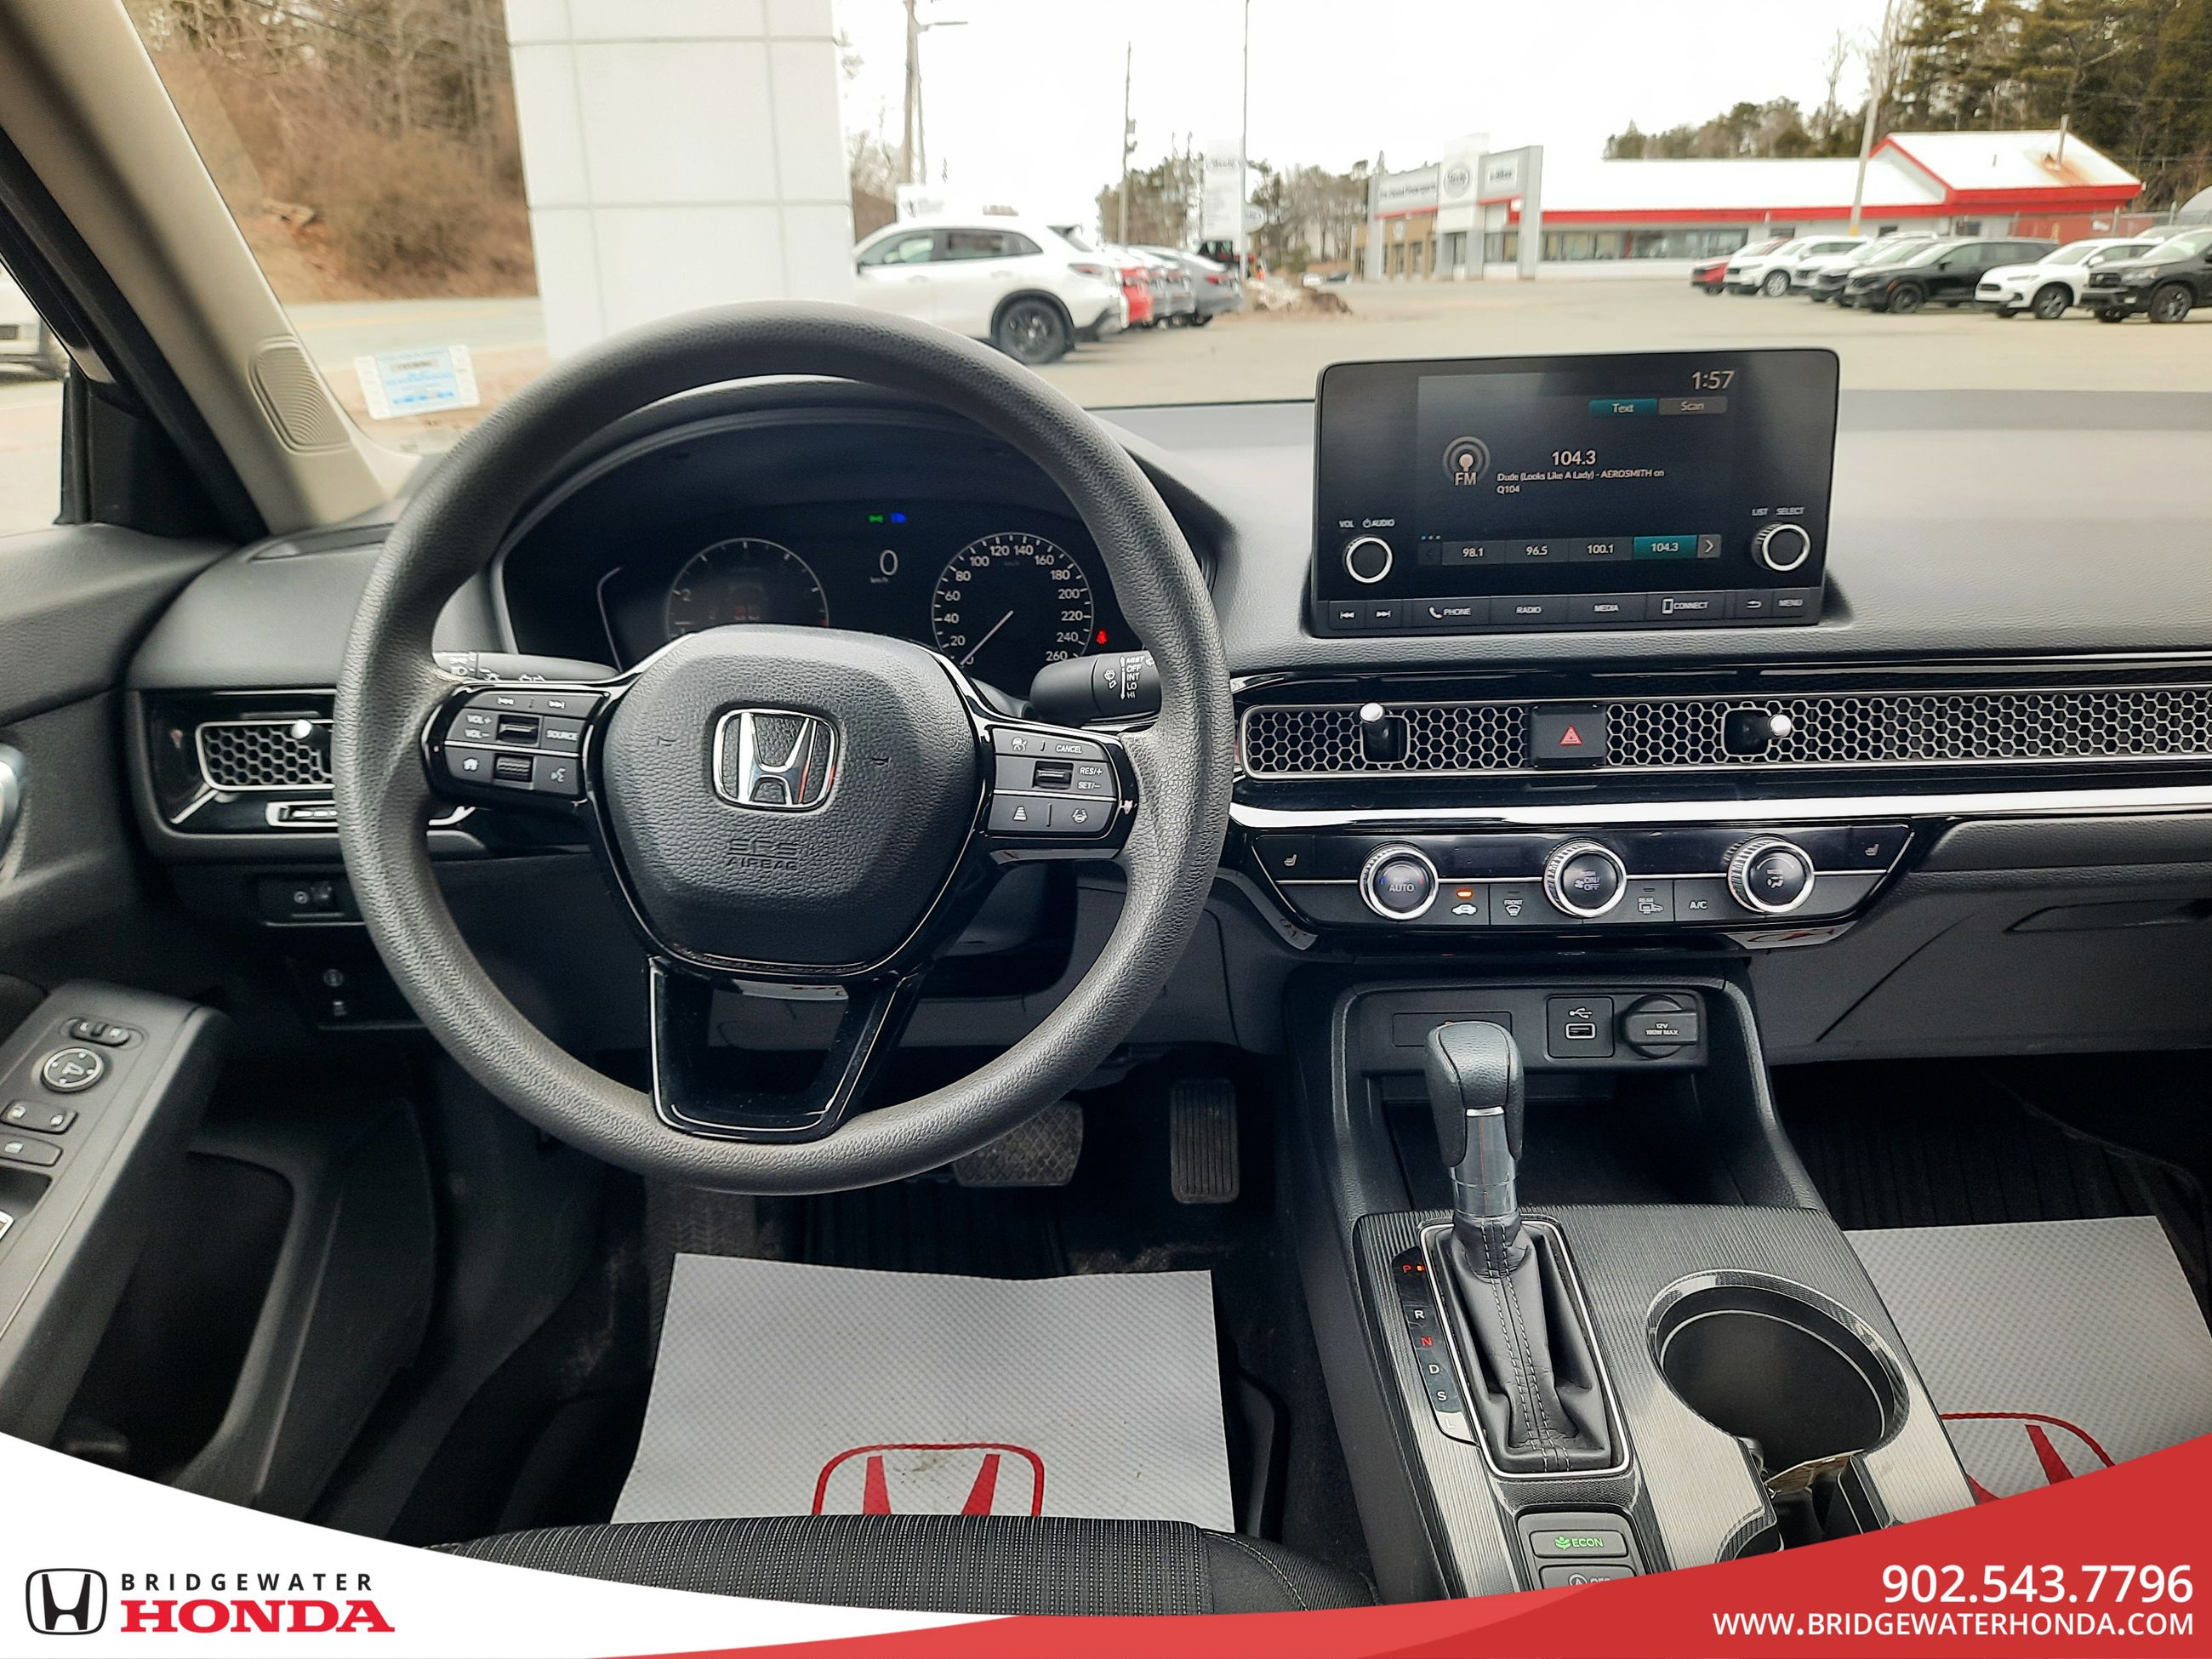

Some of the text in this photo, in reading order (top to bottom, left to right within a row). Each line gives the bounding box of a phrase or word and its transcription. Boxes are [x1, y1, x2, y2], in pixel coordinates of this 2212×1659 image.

[1691, 371, 1735, 391] 1:57
[1612, 403, 1634, 413] Text
[1680, 402, 1705, 412] Scan
[1551, 450, 1597, 466] 104.3
[1455, 472, 1477, 486] FM
[1497, 473, 1519, 482] Dude
[1520, 472, 1545, 482] (Looks
[1547, 472, 1564, 481] Like
[1564, 471, 1572, 480] A
[1573, 470, 1594, 481] Lady)
[1600, 470, 1652, 478] AEROSMITH
[1497, 485, 1520, 494] Q104
[1751, 507, 1804, 516] LIST SELECT
[1371, 518, 1395, 527] AUDIO
[989, 544, 1011, 556] 120
[1013, 544, 1035, 556] 140
[1525, 545, 1548, 556] 96.5
[1587, 544, 1614, 554] 100.1
[1650, 542, 1679, 552] 104.3
[1462, 547, 1484, 558] 98.1
[879, 550, 898, 576] 0
[969, 556, 990, 567] 100
[1035, 555, 1055, 566] 160
[955, 571, 972, 582] 80
[1050, 569, 1071, 580] 180
[944, 590, 961, 601] 60
[1058, 588, 1080, 600] 200
[1515, 606, 1542, 614] RADIO
[1593, 604, 1619, 613] MEDIA
[1673, 601, 1708, 610] CONNECT
[1061, 610, 1084, 621] 220
[1444, 607, 1471, 617] PHONE
[944, 613, 960, 624] 40
[950, 636, 966, 647] 20
[1056, 631, 1079, 642] 240
[1046, 651, 1069, 662] 260
[1126, 655, 1145, 664] MIST
[1126, 664, 1142, 673] OFF
[1126, 672, 1140, 681] INT
[1126, 681, 1137, 691] LO
[546, 729, 579, 741] SOURCE
[1055, 744, 1083, 754] CANCEL
[1079, 767, 1103, 776] RES/+
[1388, 883, 1415, 892] AUTO
[1689, 900, 1707, 909] A/C
[1403, 1265, 1411, 1274] P
[1414, 1310, 1425, 1320] R
[1420, 1337, 1433, 1347] N
[1428, 1364, 1440, 1374] D
[1437, 1391, 1447, 1402] S
[1446, 1417, 1456, 1429] L
[1571, 1538, 1604, 1548] ECON
